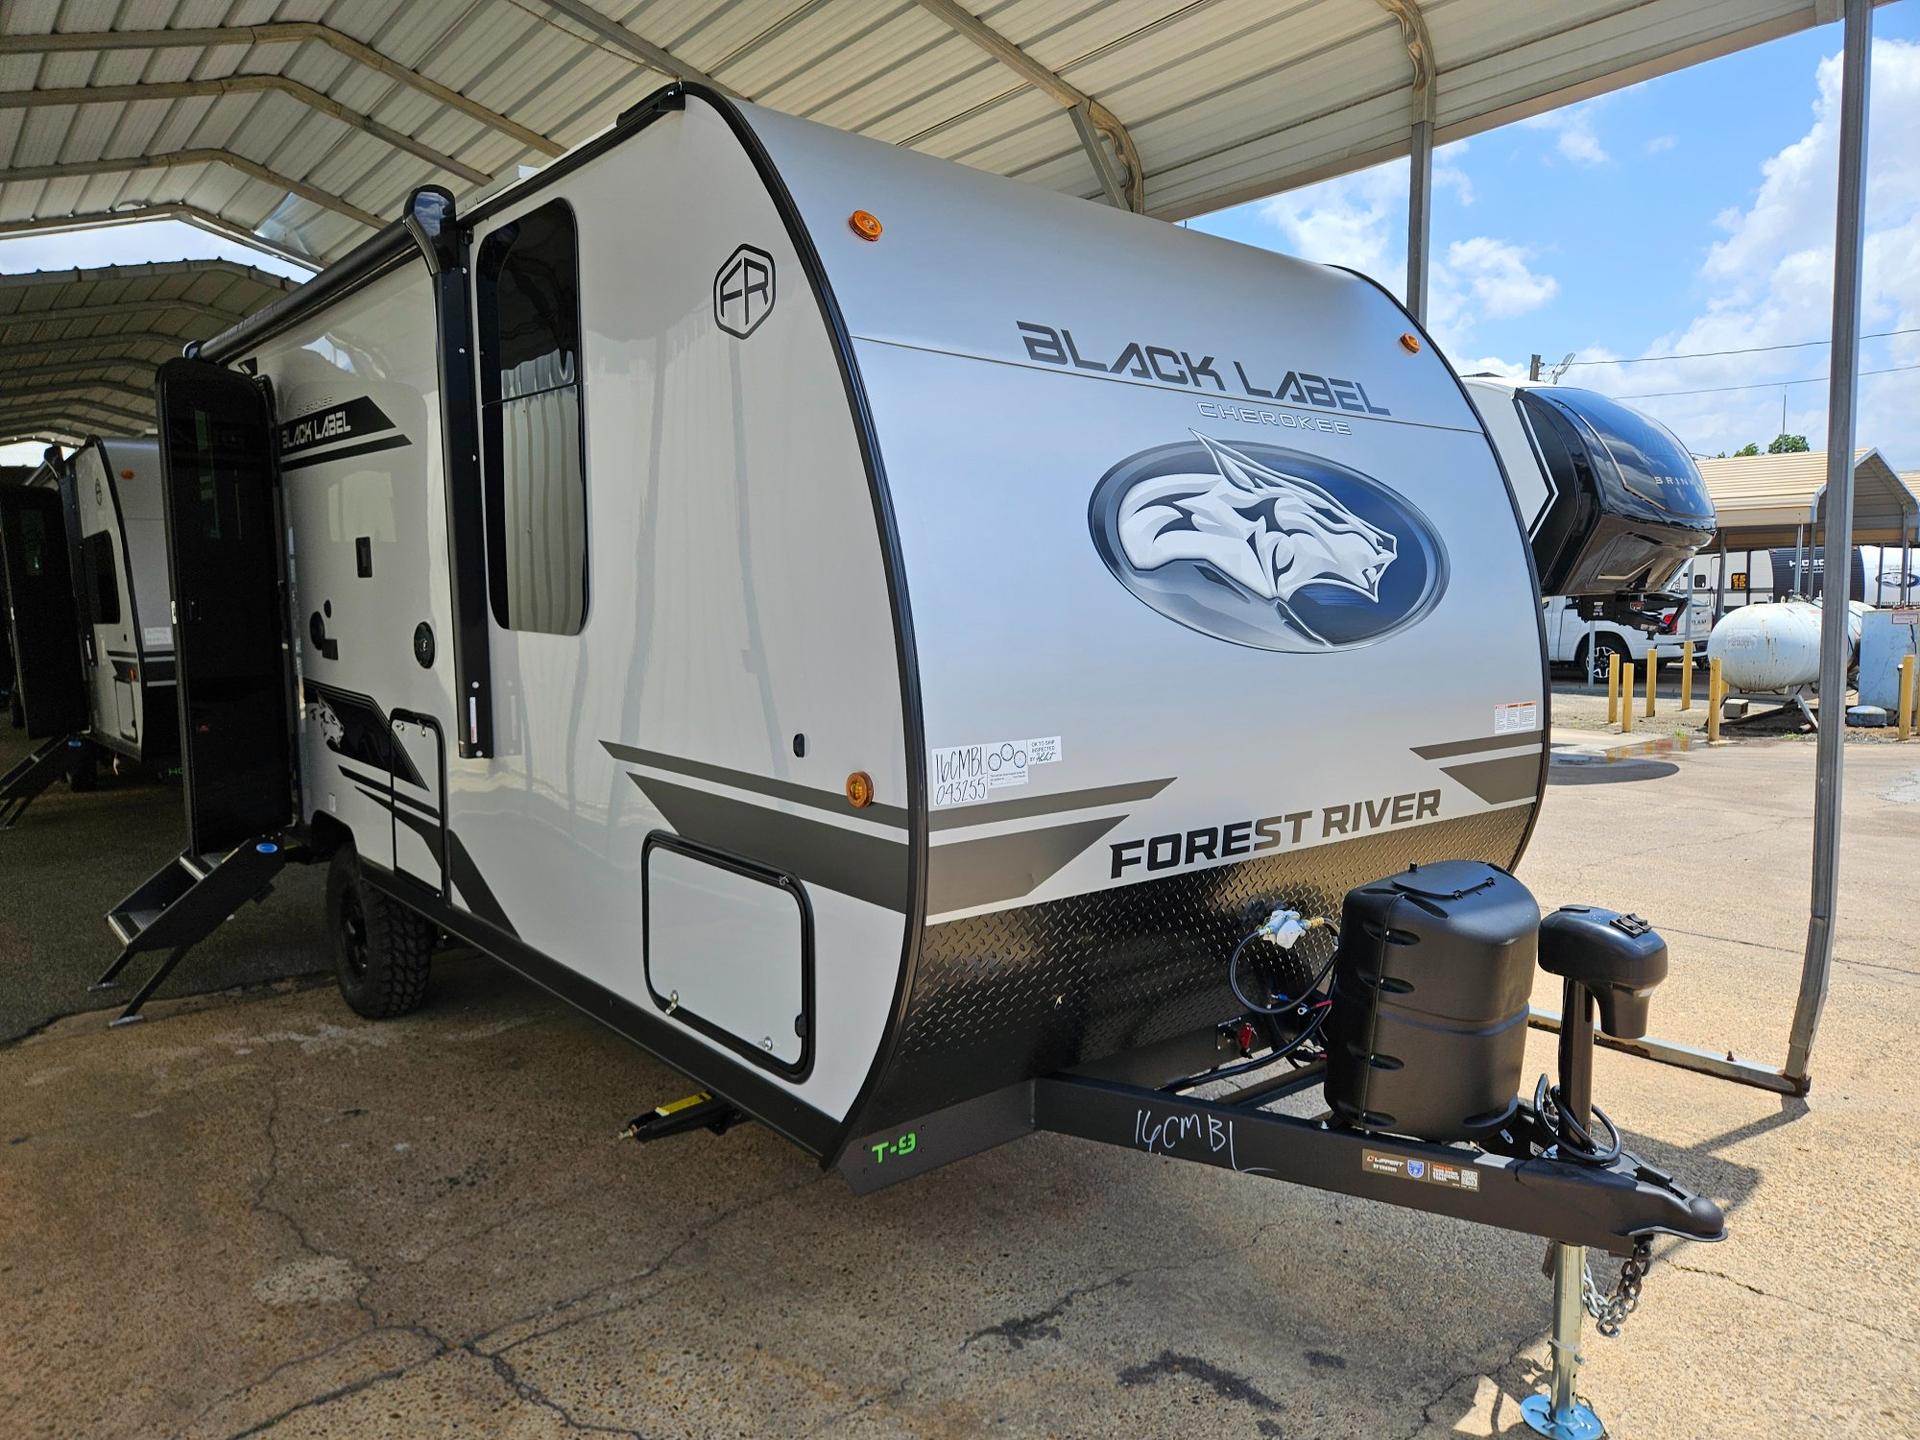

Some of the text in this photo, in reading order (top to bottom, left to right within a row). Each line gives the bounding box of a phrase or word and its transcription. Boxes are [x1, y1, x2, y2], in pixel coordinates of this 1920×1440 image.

[1015, 320, 1392, 416] BLACK LABEL
[281, 410, 352, 449] BLACK LABEL
[1195, 400, 1353, 436] CHEROKEE
[1109, 788, 1441, 879] FOREST RIVER
